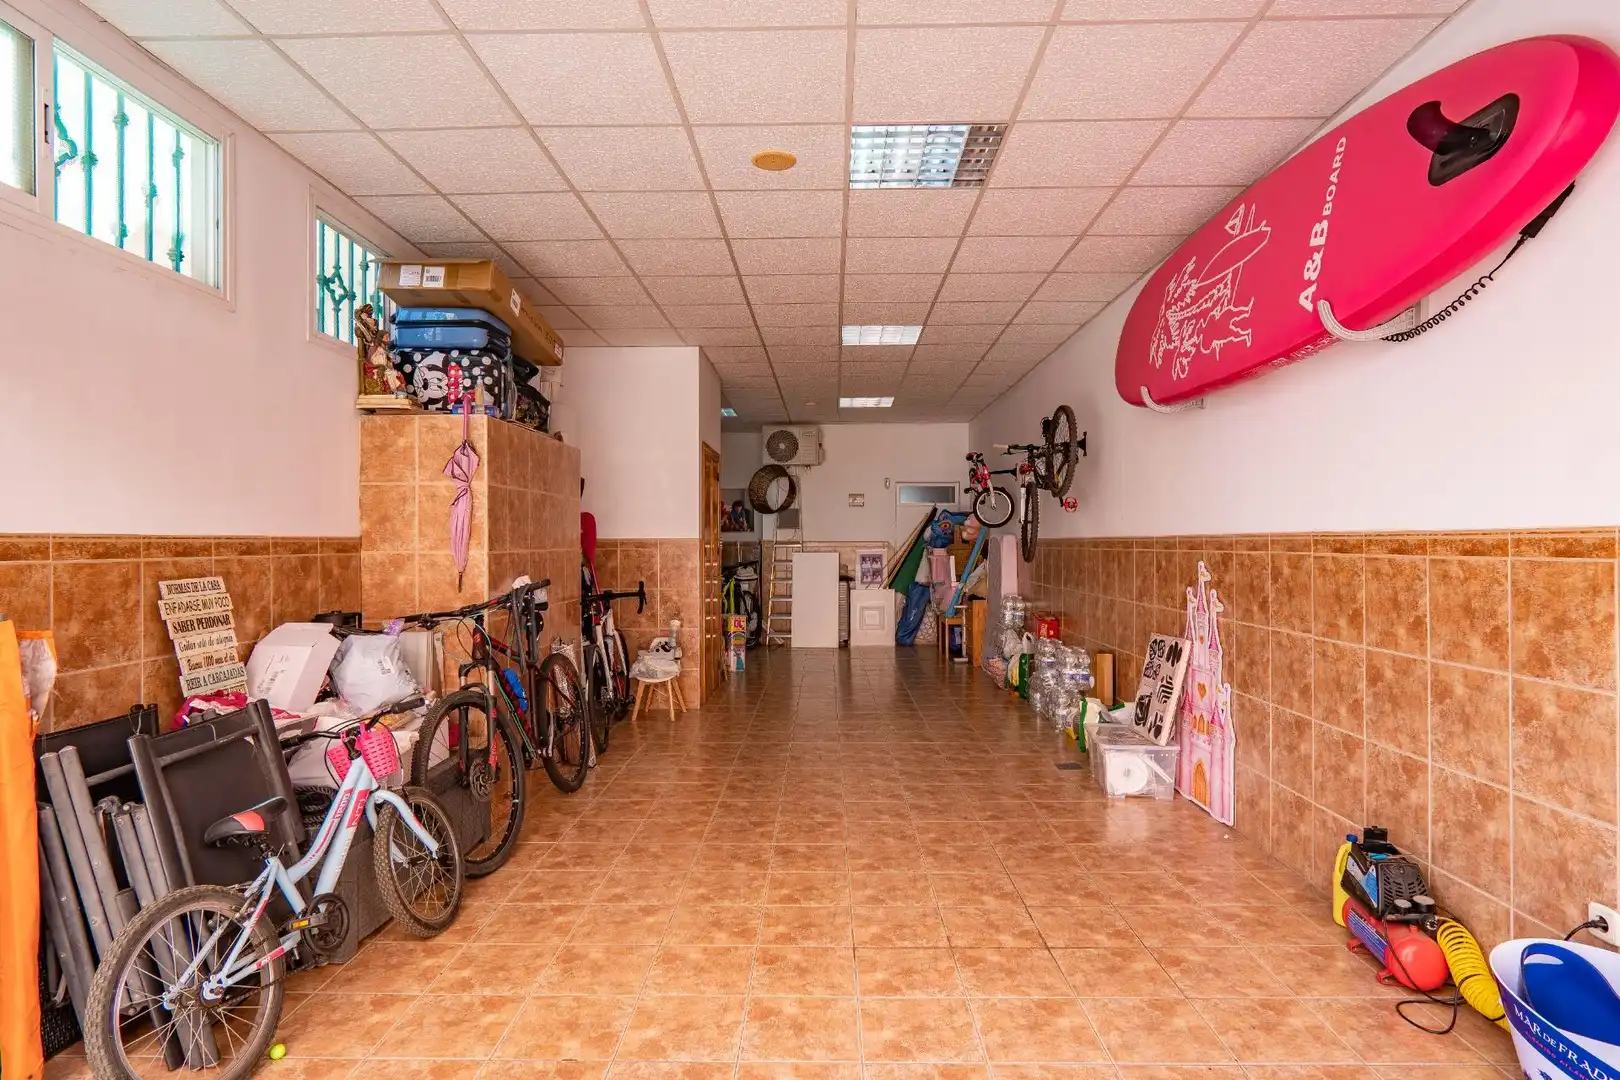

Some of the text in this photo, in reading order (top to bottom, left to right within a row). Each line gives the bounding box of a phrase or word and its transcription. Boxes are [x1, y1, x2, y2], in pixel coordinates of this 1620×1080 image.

[1299, 137, 1347, 313] A&B BOARD
[166, 580, 221, 595] NORMAS DE LA CASA
[164, 596, 230, 615] ENFADARSE MUY POCO
[172, 614, 231, 634] SABER PERDONAR
[208, 666, 245, 685] CARCAJADAS
[1513, 1003, 1616, 1080] MAR DE FRAD
